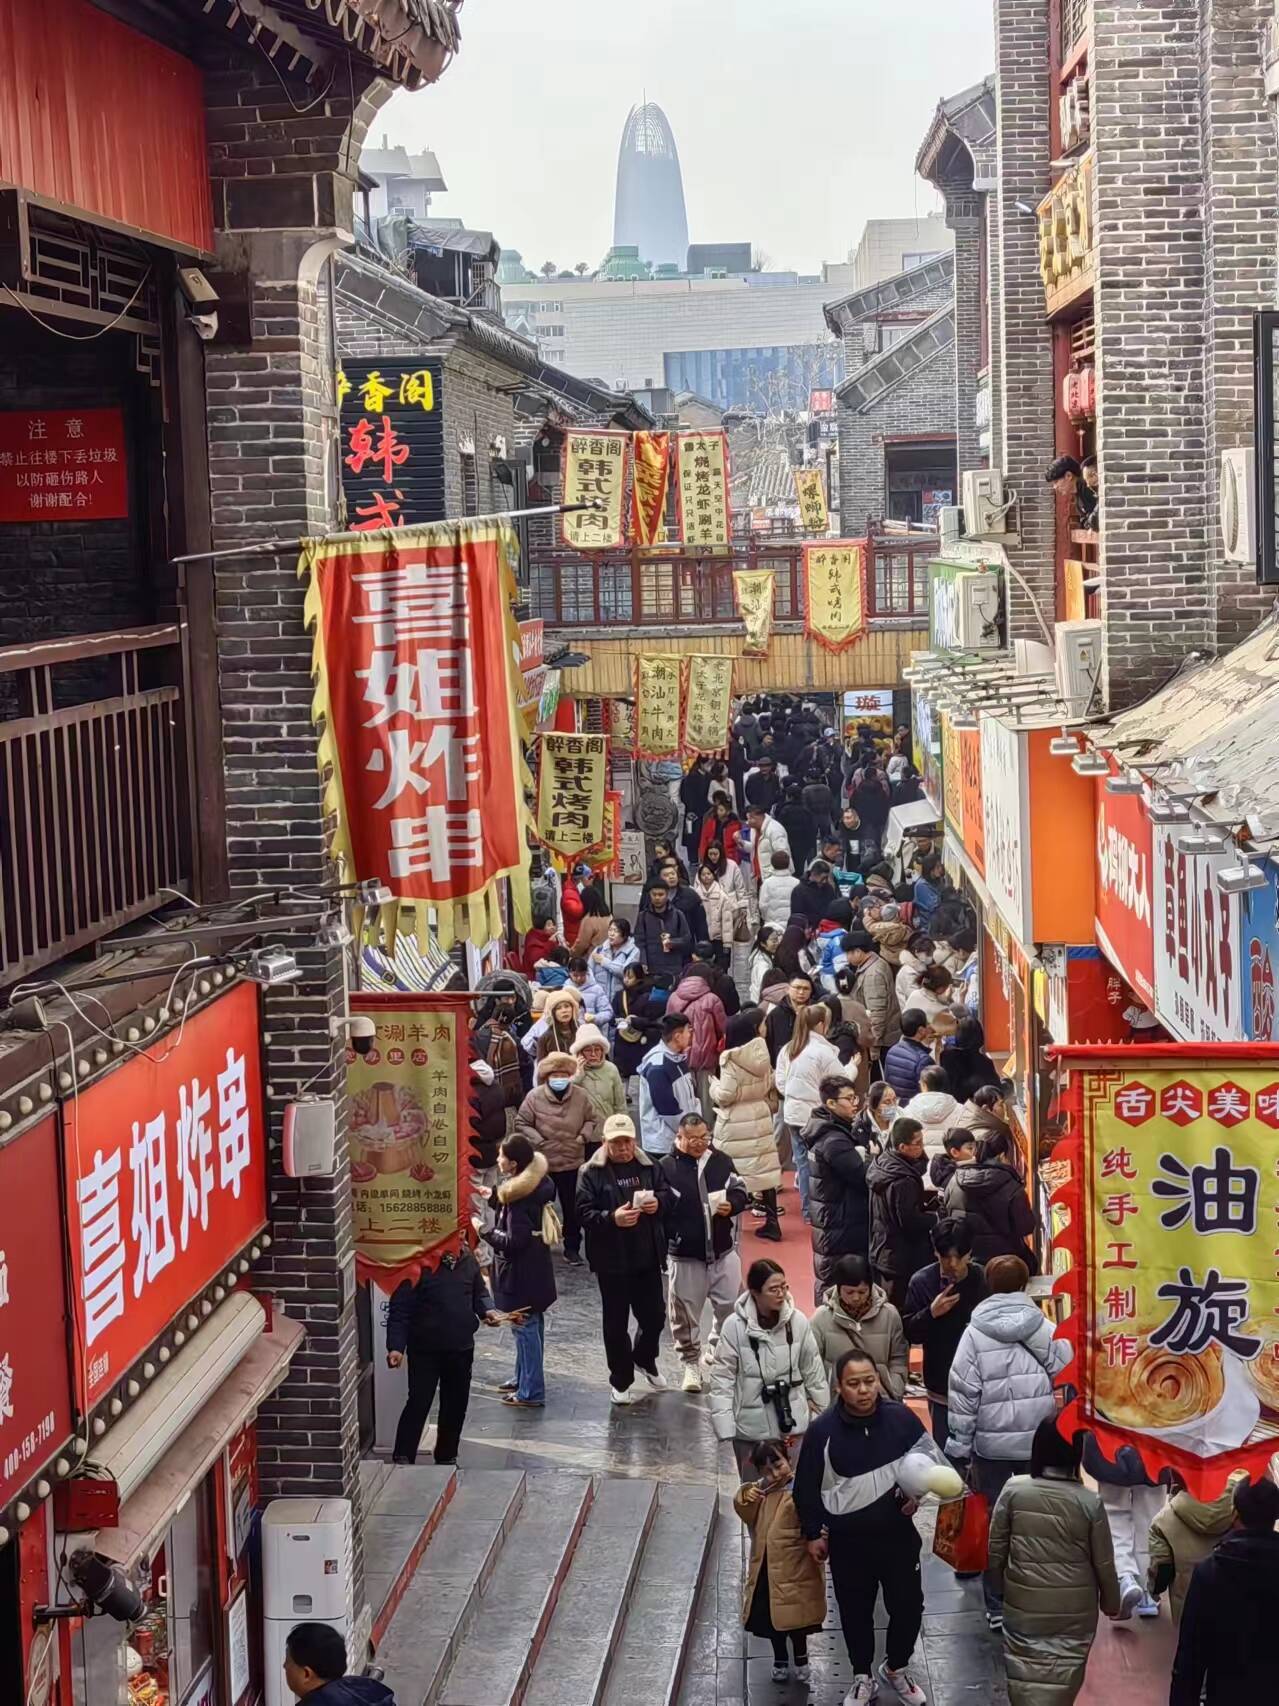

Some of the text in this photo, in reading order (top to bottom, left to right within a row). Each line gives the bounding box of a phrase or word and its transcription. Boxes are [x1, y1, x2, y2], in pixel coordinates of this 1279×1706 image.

[28, 419, 85, 440] 注意
[571, 437, 621, 456] 醉香阁
[16, 470, 104, 487] 以防砸伤路人
[651, 664, 666, 741] 潮汕牛肉
[351, 563, 484, 883] 喜姐炸串
[546, 736, 603, 754] 醉香阁
[552, 757, 593, 829] 韩式烤肉
[545, 831, 593, 845] 请上二楼
[1116, 1086, 1279, 1120] 舌尖美味
[76, 1046, 250, 1347] 喜姐炸串
[352, 1217, 442, 1234] 上二楼
[1101, 1146, 1138, 1369] 纯手工制作
[1151, 1145, 1264, 1361] 油旋
